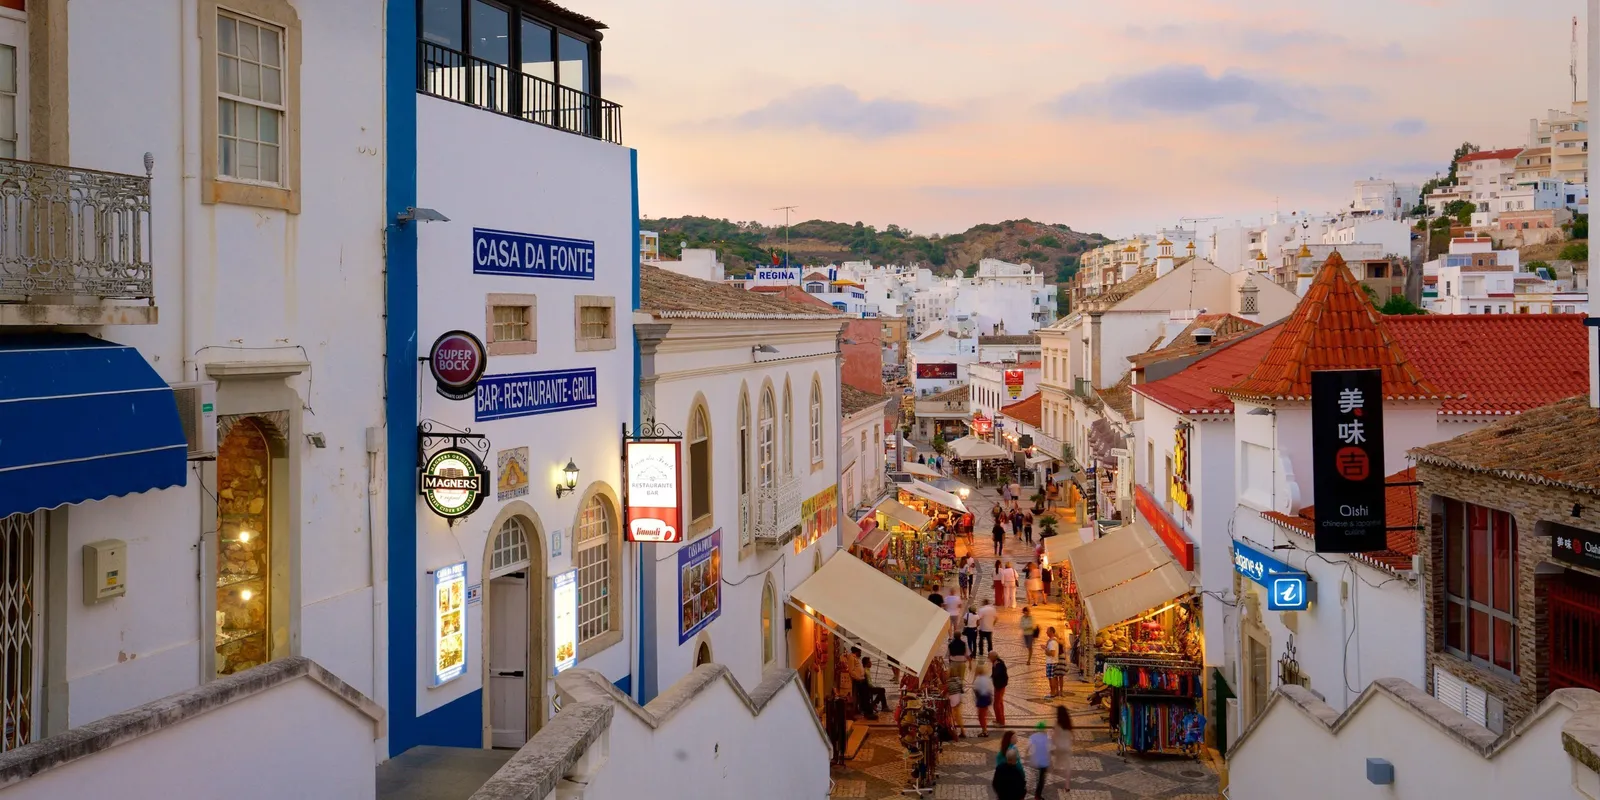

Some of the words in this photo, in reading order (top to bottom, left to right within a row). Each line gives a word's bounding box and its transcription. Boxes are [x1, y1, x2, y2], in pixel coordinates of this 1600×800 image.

[476, 237, 520, 268] CASA
[525, 242, 546, 269] DA
[550, 245, 593, 273] FONTE
[759, 271, 795, 280] REGINA
[438, 349, 472, 360] SUPER
[439, 360, 470, 370] BOCK
[430, 454, 451, 472] MAGNERS
[452, 454, 473, 474] ORIGINAL
[425, 477, 477, 489] MAGNERS
[1339, 505, 1369, 516] Oishi
[1235, 548, 1255, 573] algarve
